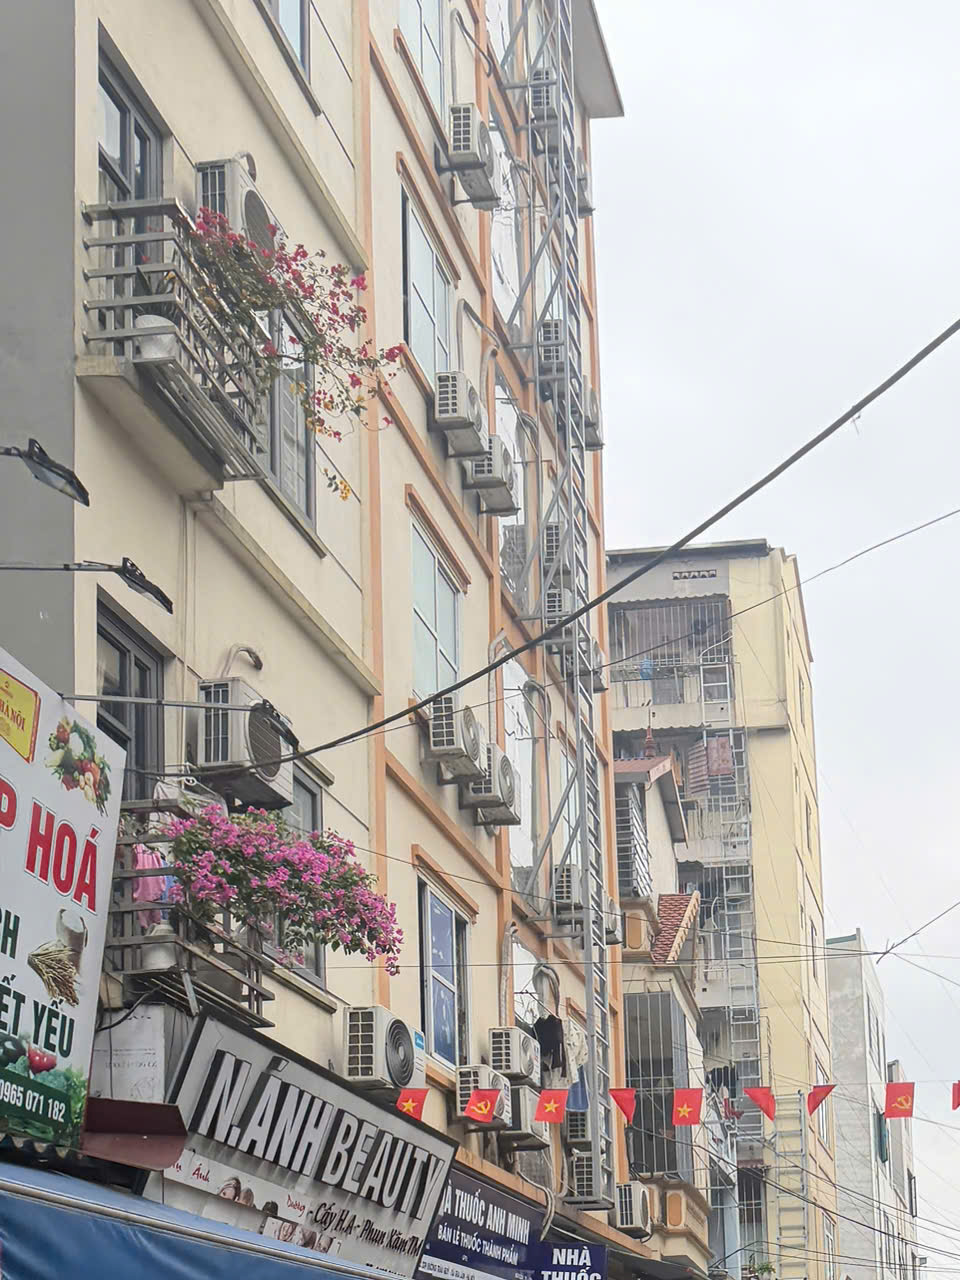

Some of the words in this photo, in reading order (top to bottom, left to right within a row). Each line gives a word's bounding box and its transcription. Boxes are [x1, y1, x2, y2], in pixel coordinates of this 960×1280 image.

[25, 797, 100, 914] HOÁ
[32, 996, 75, 1059] YẾU
[25, 1089, 44, 1115] 071
[48, 1098, 66, 1123] 182
[322, 1108, 447, 1221] BEAUTY
[314, 1202, 337, 1231] Cấy
[360, 1219, 387, 1246] Phun
[437, 1222, 453, 1244] BÁN
[460, 1232, 481, 1253] THUỐC
[454, 1188, 486, 1227] THUỐC
[486, 1204, 507, 1236] ANH
[506, 1212, 531, 1245] MINH
[552, 1245, 592, 1266] NHÀ
